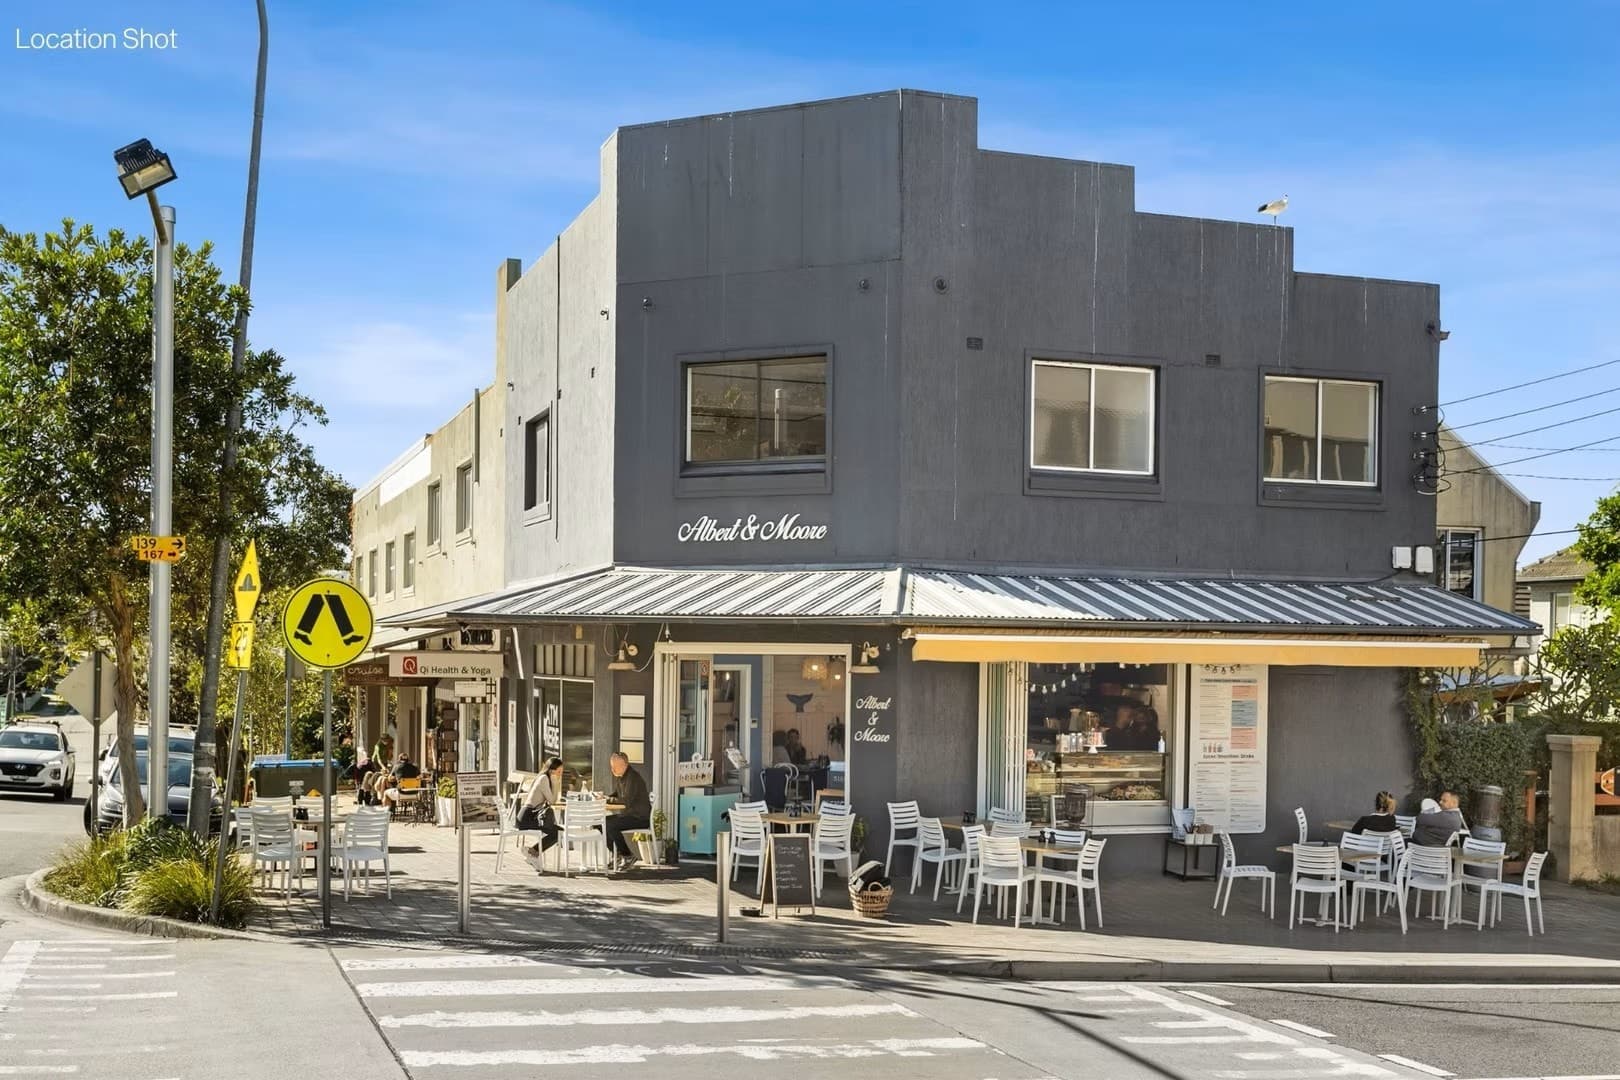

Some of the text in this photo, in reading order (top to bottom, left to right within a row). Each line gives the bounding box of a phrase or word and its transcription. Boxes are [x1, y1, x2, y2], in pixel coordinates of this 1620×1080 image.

[677, 513, 828, 542] Albert & Moore
[135, 538, 157, 549] 139
[143, 550, 164, 559] 167
[419, 665, 492, 676] Qi Health & Yoga
[855, 695, 892, 710] Albert
[545, 703, 559, 727] ATM
[867, 711, 879, 726] &
[854, 727, 891, 743] Moore
